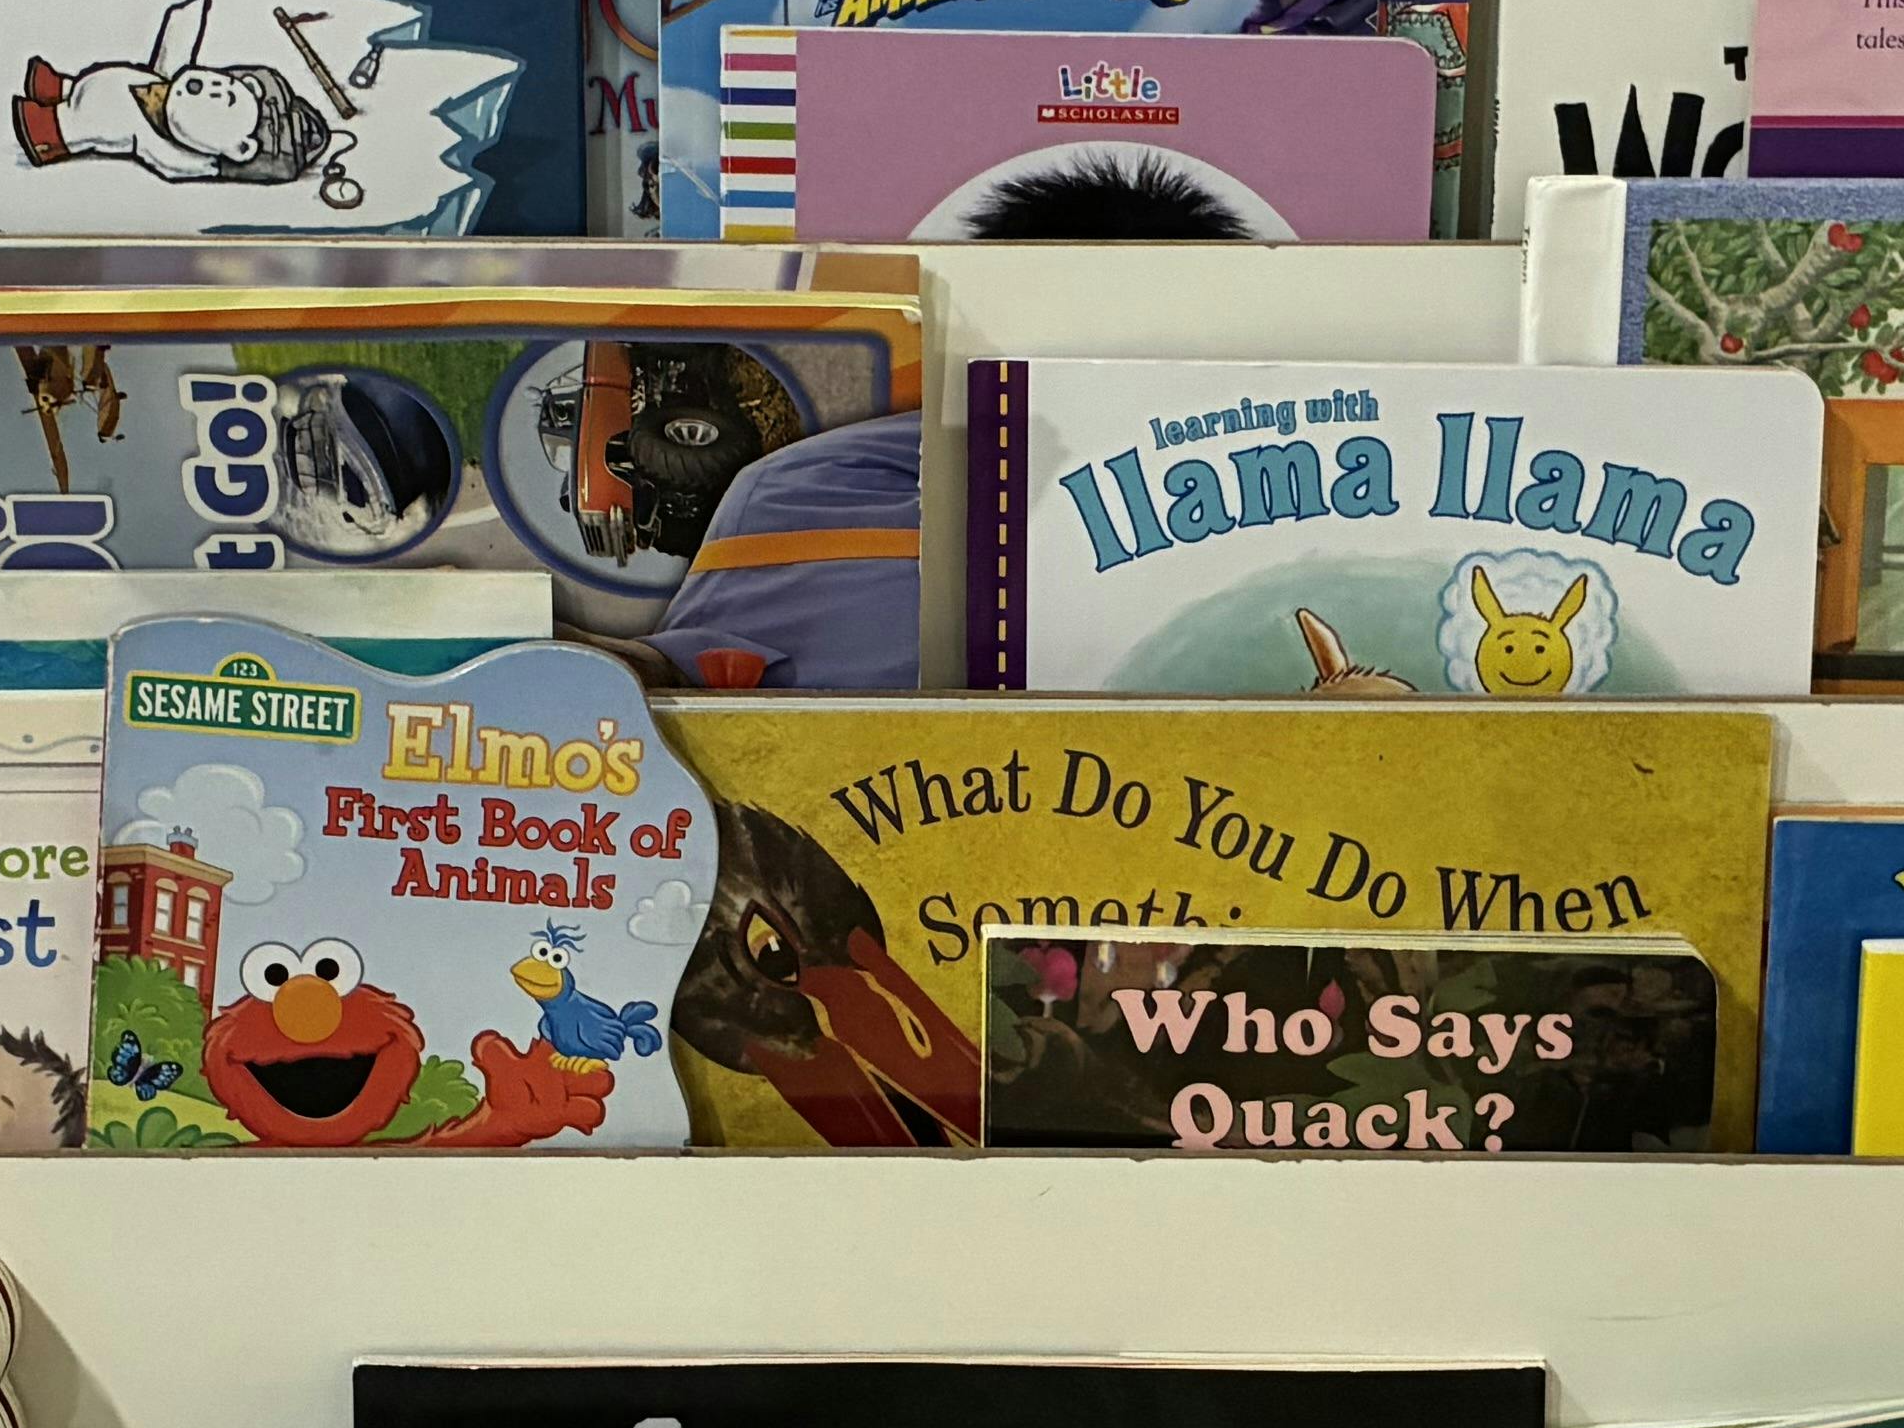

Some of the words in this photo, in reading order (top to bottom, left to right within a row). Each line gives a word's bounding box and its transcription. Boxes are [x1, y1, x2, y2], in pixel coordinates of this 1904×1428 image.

[1058, 61, 1160, 102] Little
[1057, 107, 1178, 122] SCHOLASTIC
[1148, 397, 1296, 450] learning
[1305, 389, 1380, 424] with
[1058, 434, 1400, 573] llama
[1427, 411, 1757, 584] llama
[233, 663, 258, 677] 123
[136, 682, 241, 725] SESAME
[251, 691, 350, 733] STREET
[382, 703, 642, 796] Elmo's
[322, 787, 462, 844] First
[478, 798, 619, 855] Book
[630, 808, 693, 860] of
[832, 749, 1032, 849] What
[1052, 748, 1153, 832] Do
[1173, 775, 1295, 881] You
[1308, 832, 1409, 920] Do
[1434, 866, 1652, 933] When
[391, 848, 616, 911] Animals
[1111, 987, 1335, 1057] Who
[1367, 993, 1576, 1075] Says
[1168, 1083, 1516, 1150] Quack?
